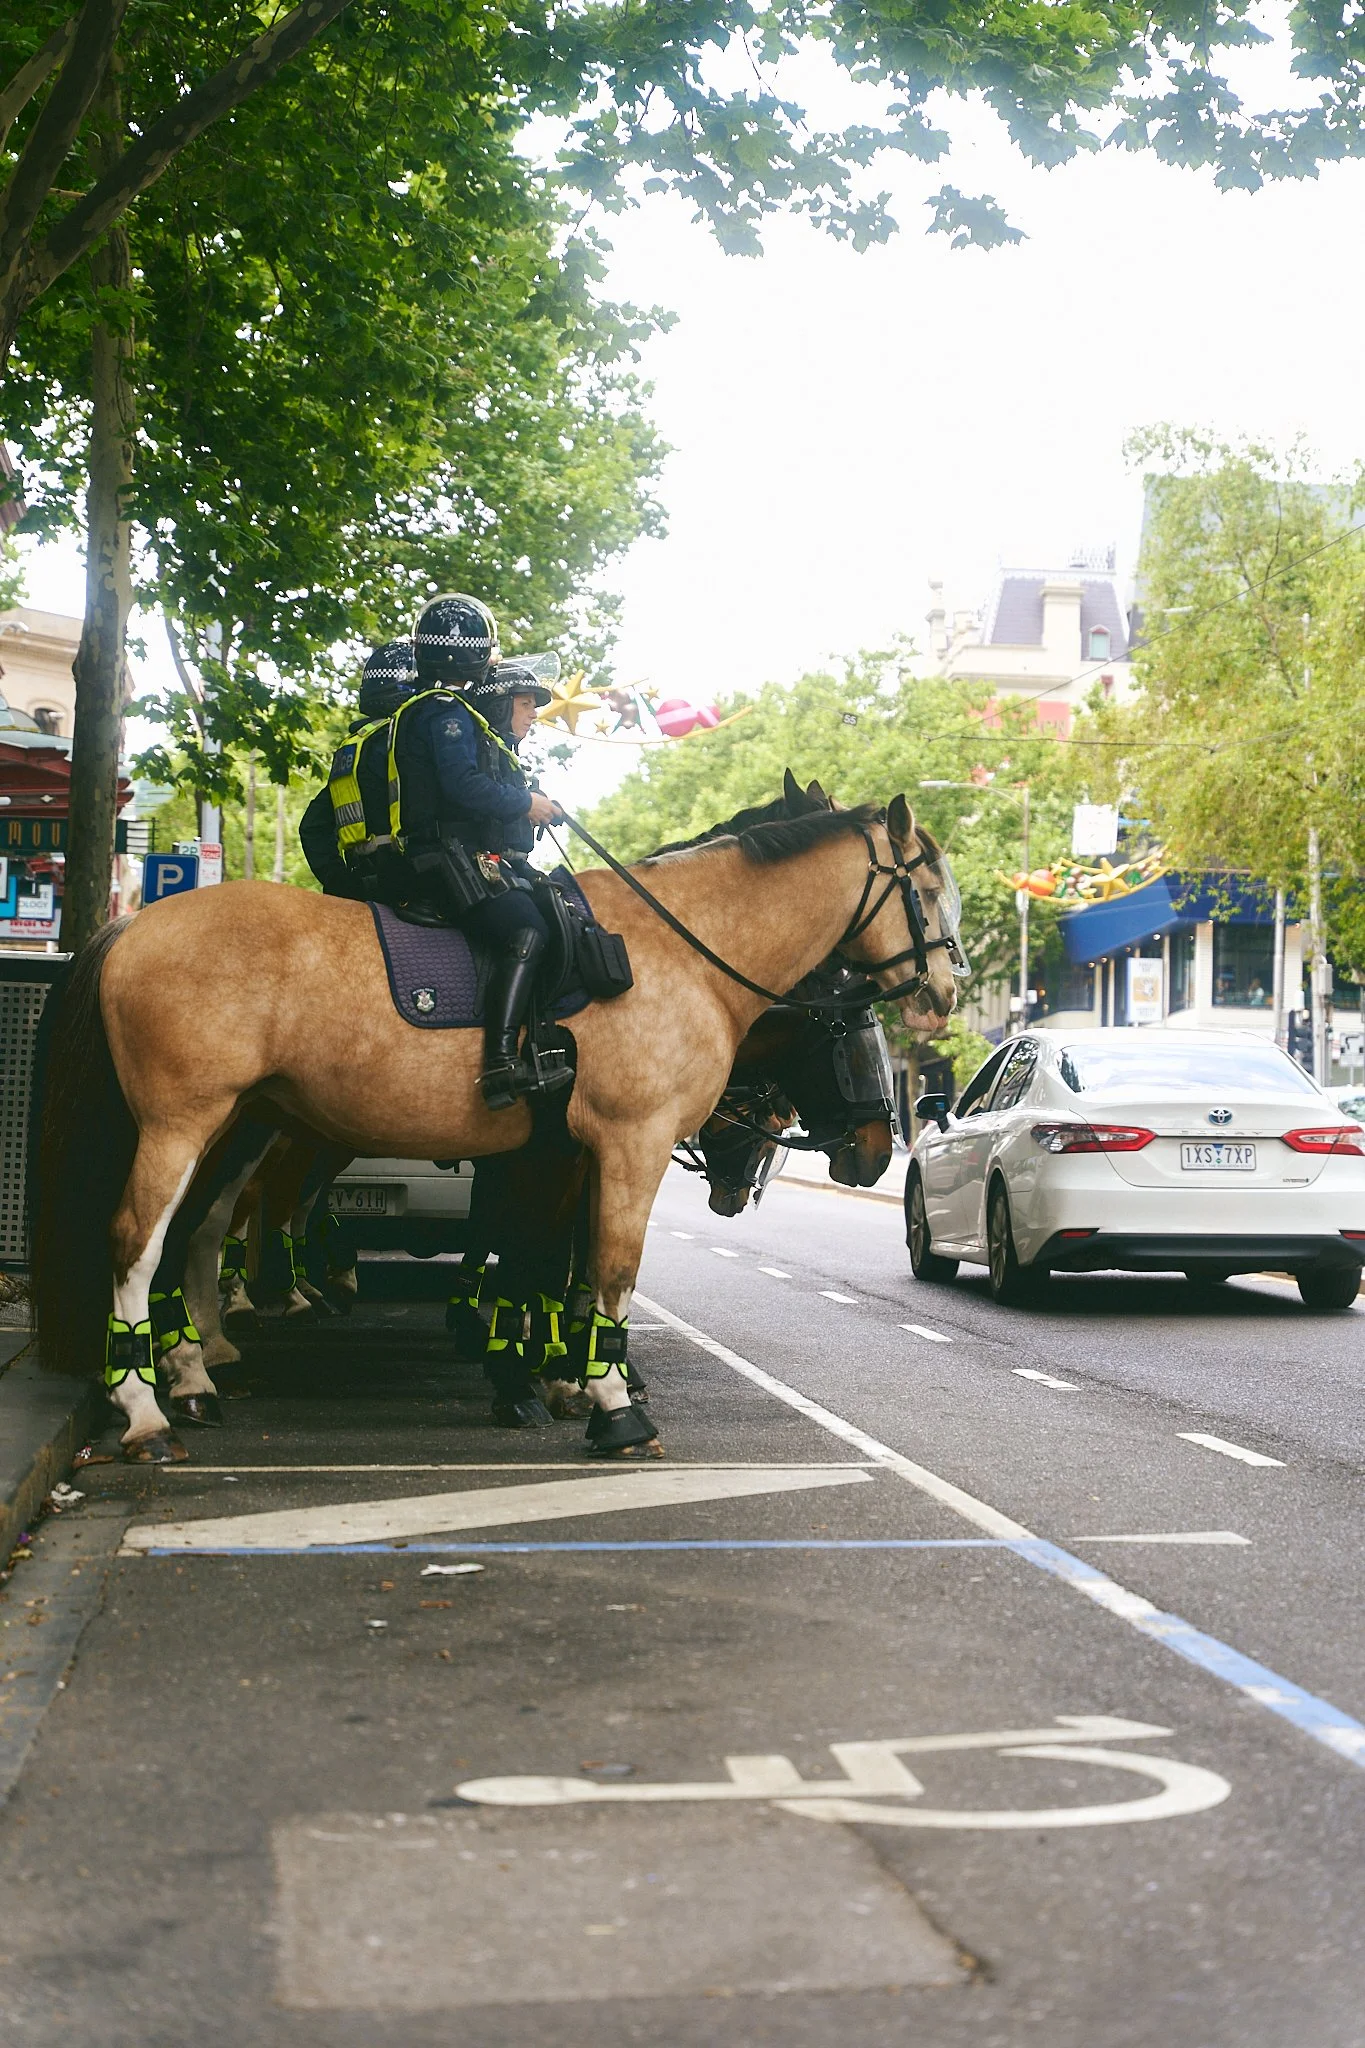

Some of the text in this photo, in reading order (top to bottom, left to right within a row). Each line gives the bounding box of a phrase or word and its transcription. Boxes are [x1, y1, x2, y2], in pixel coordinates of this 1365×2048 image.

[844, 714, 857, 725] 55
[157, 864, 184, 896] P
[1186, 1147, 1253, 1164] 1XS 7XP
